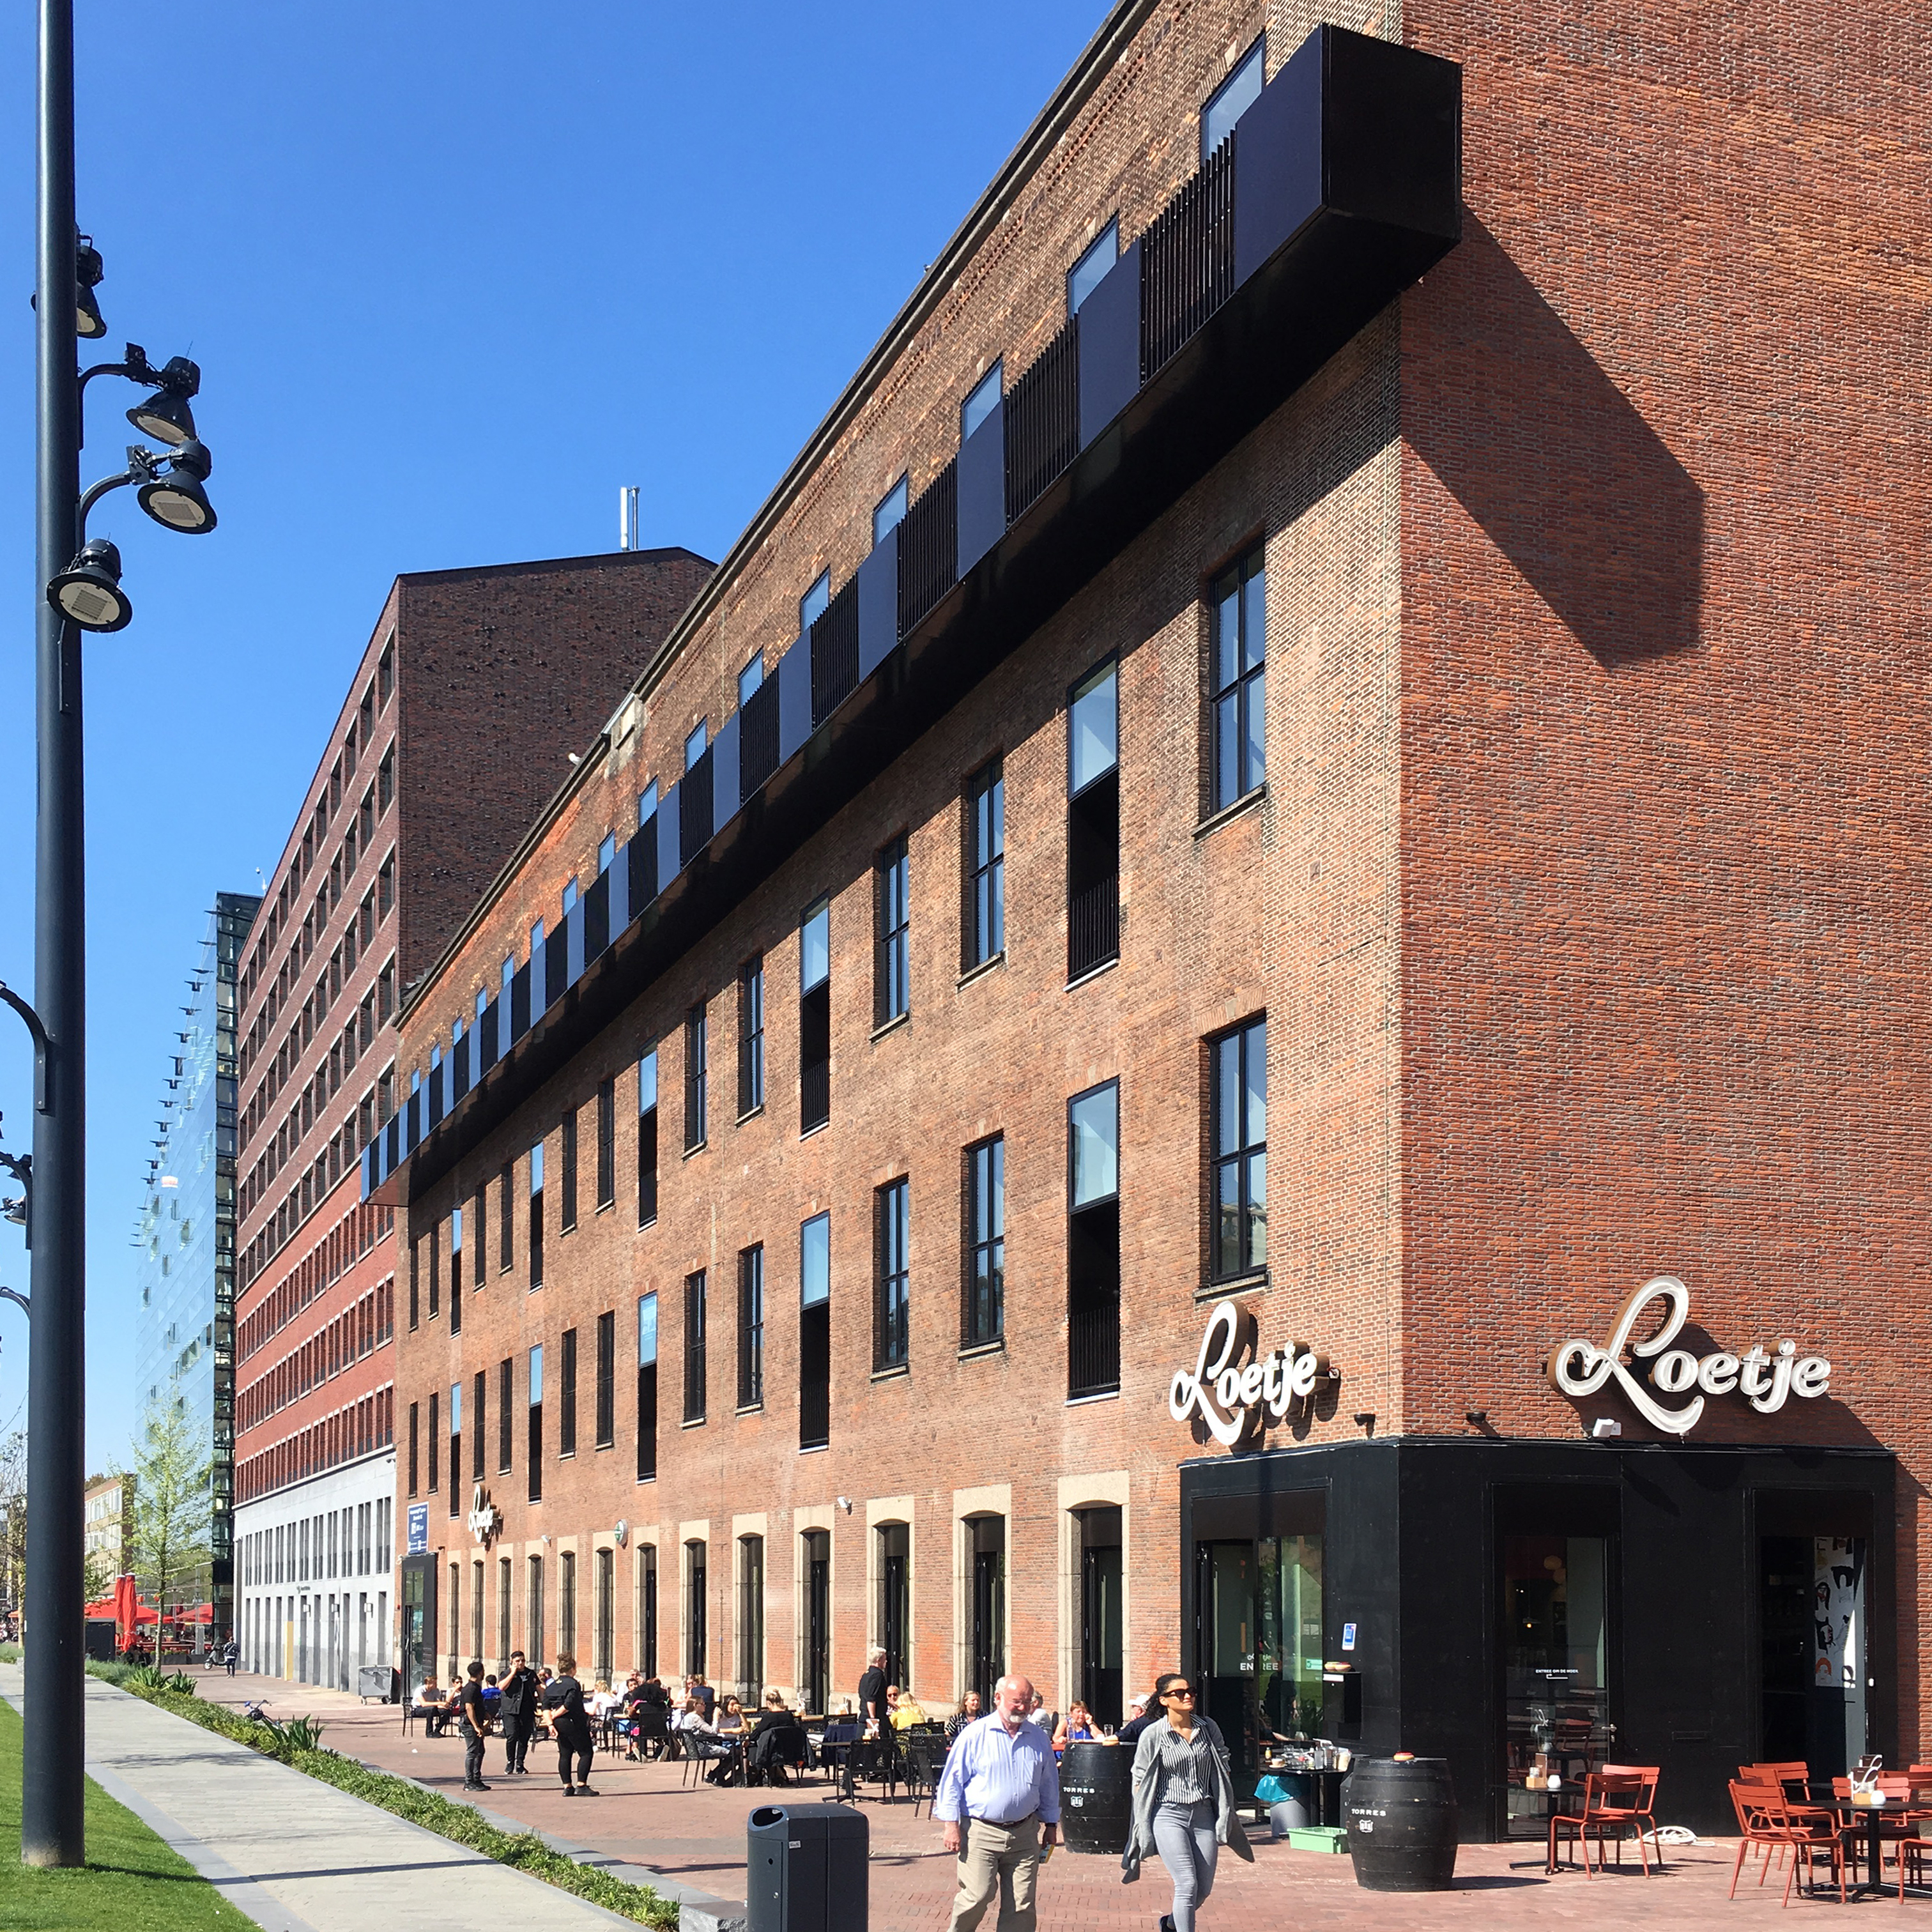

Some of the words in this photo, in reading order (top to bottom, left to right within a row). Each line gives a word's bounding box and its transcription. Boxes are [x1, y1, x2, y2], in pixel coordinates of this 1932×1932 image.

[1169, 1300, 1318, 1446] Loetje
[1554, 1275, 1831, 1434] Loetje
[468, 1483, 494, 1543] Loetje
[1351, 1808, 1386, 1816] TORRES
